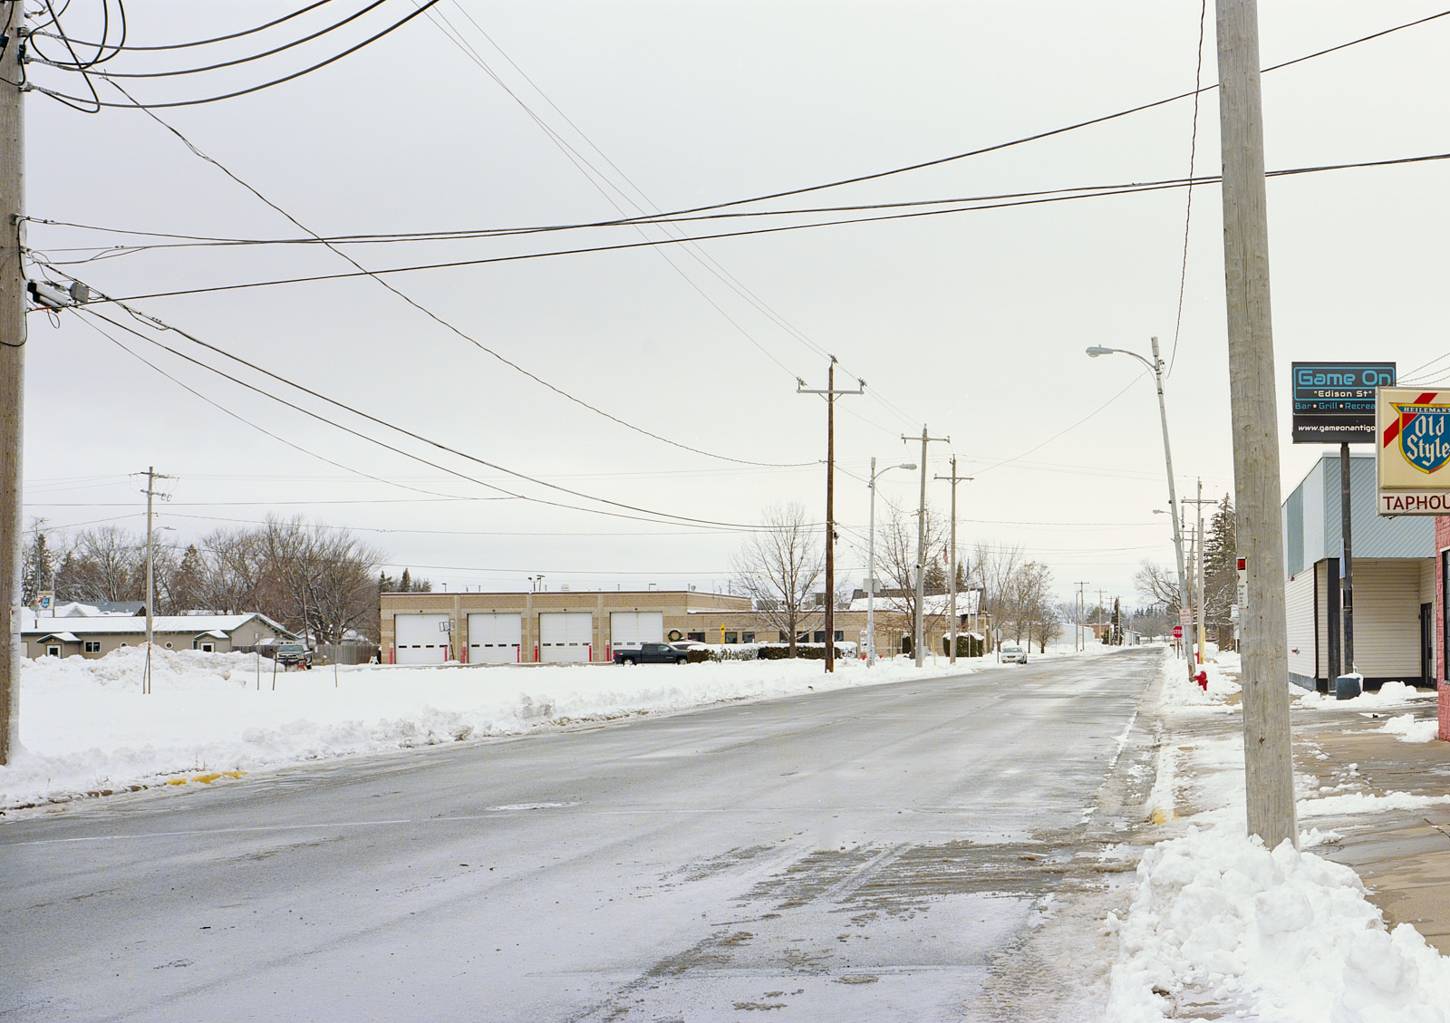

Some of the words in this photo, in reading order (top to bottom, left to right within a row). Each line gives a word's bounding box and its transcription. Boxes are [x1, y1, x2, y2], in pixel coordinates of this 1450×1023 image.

[1298, 370, 1356, 385] Game
[1362, 370, 1391, 385] On
[1295, 402, 1311, 410] Bar
[1318, 402, 1337, 410] Grill
[1415, 415, 1445, 437] Old
[1406, 434, 1450, 467] Style
